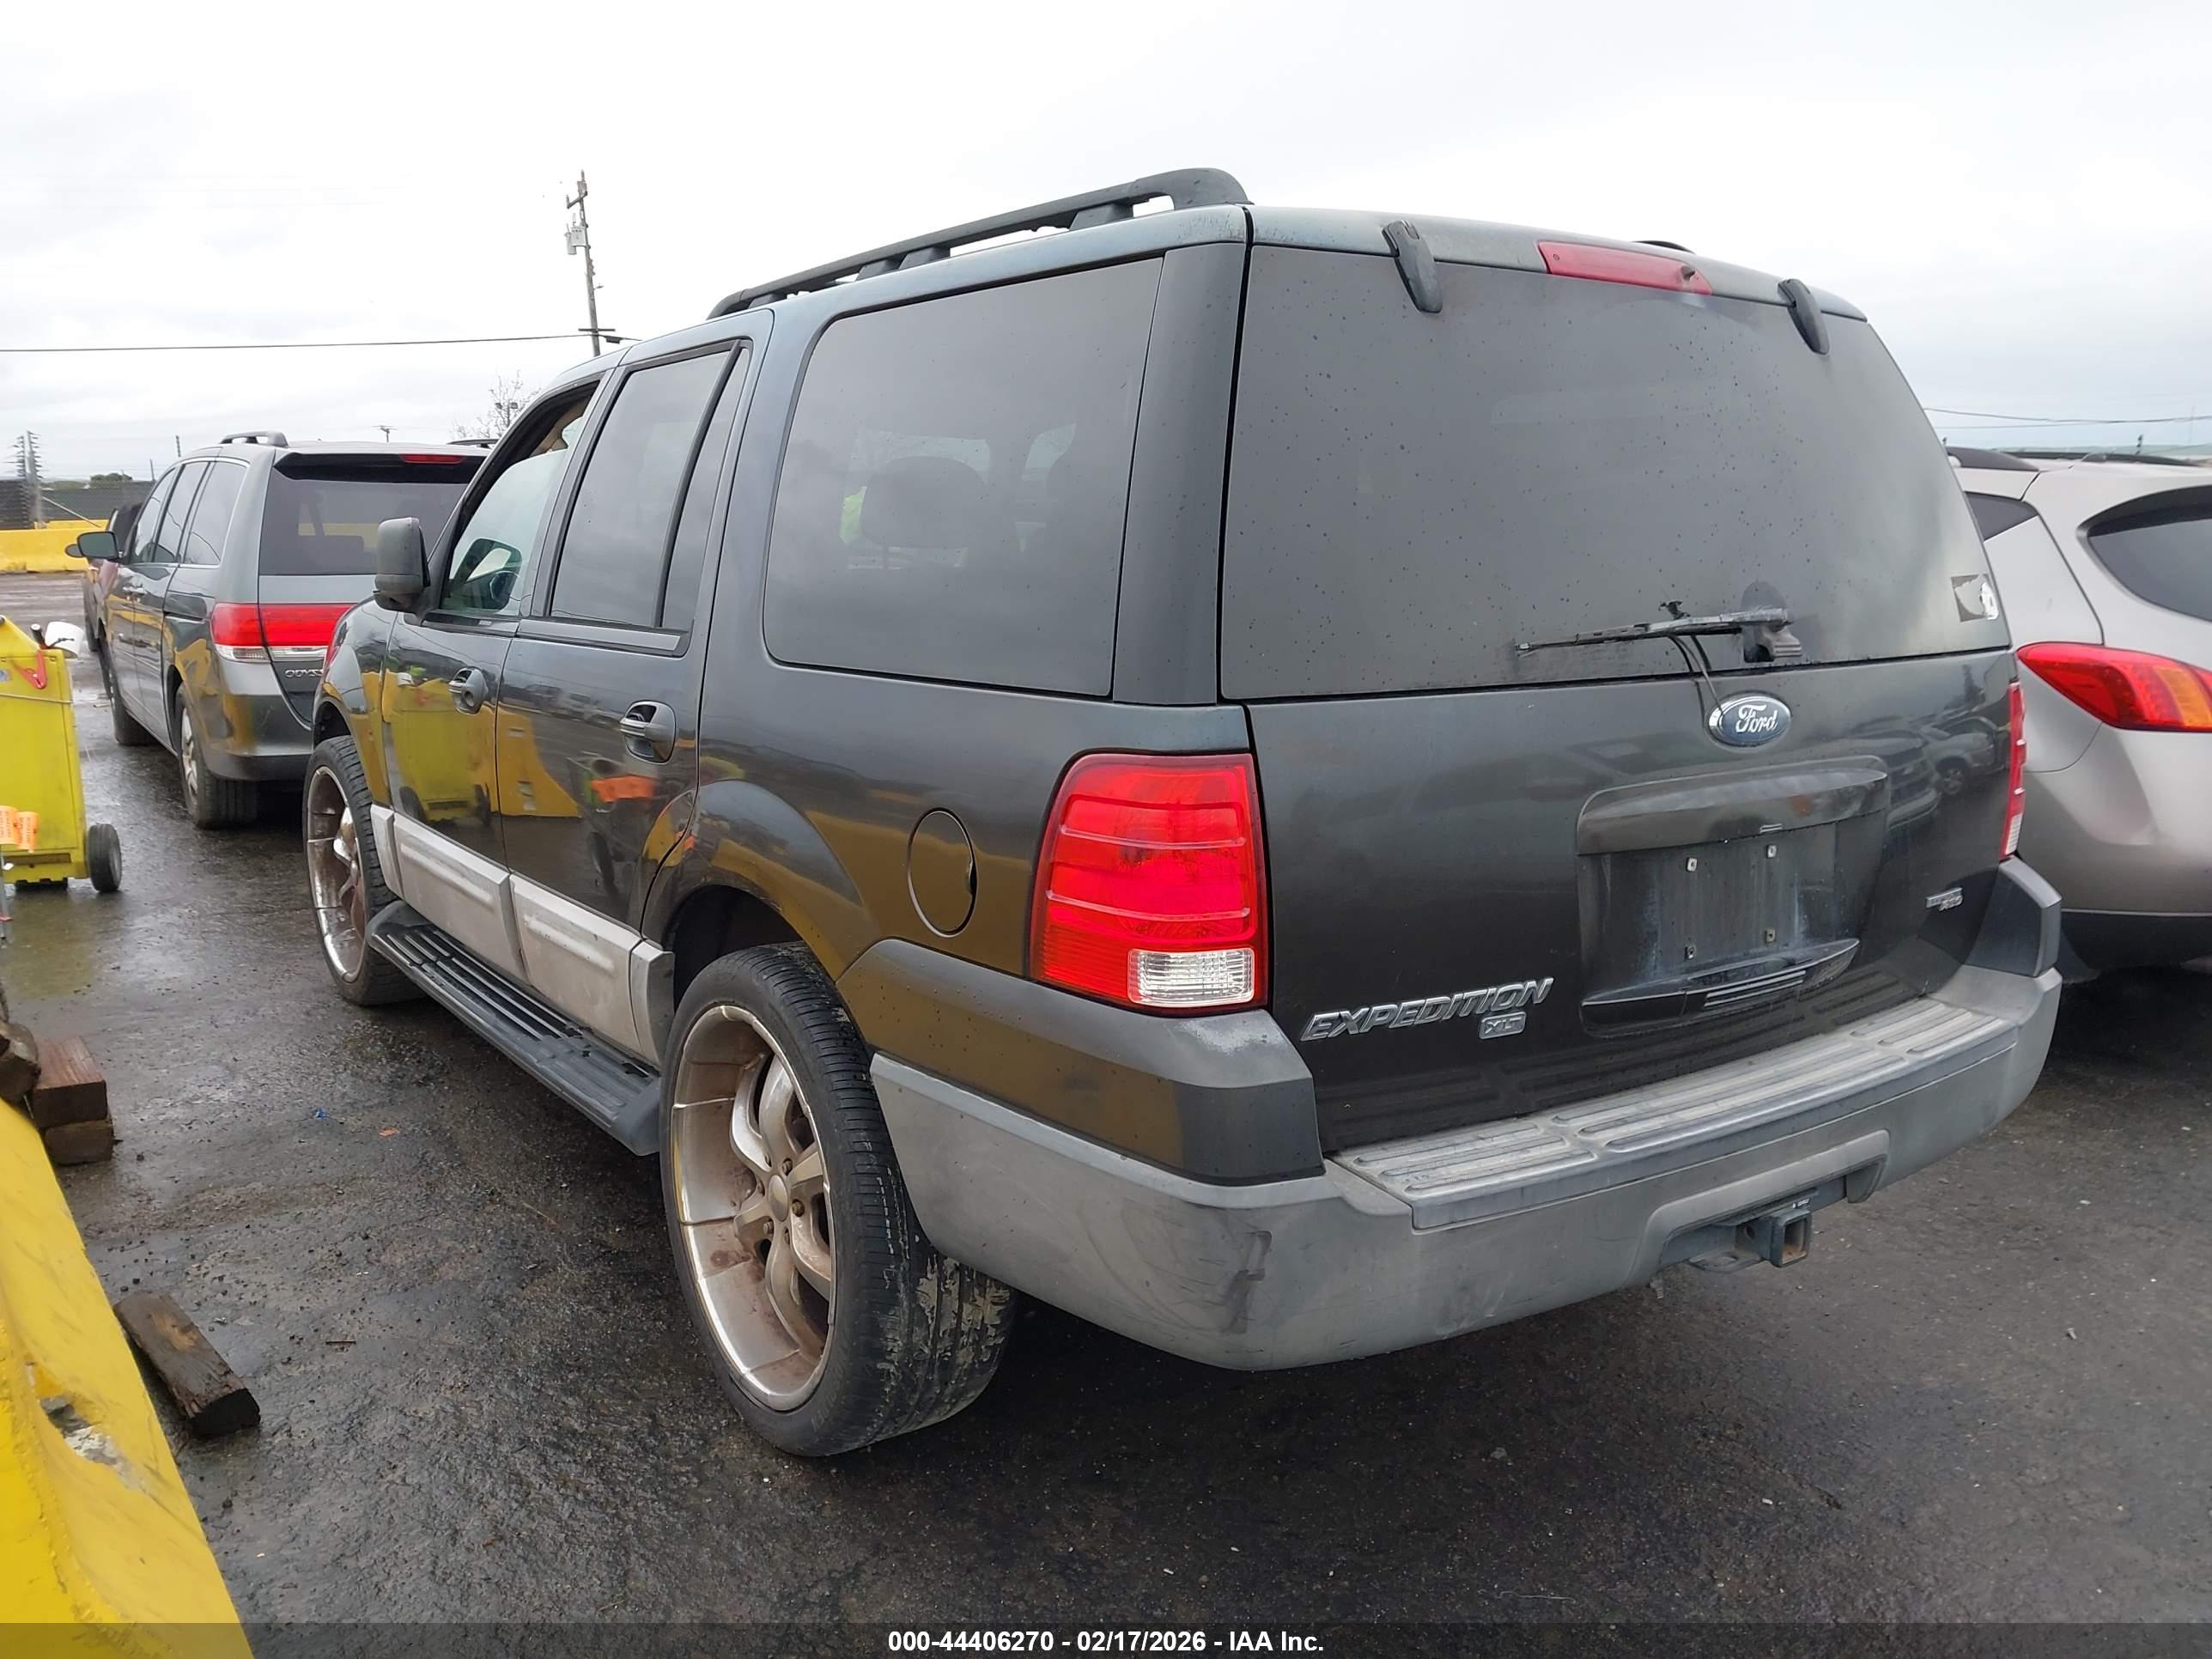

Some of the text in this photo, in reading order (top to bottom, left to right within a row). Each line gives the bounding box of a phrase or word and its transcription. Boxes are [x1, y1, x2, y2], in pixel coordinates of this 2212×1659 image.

[1735, 704, 1778, 733] Ford
[1300, 977, 1554, 1042] EXPEDITION
[1485, 1016, 1522, 1035] XLT
